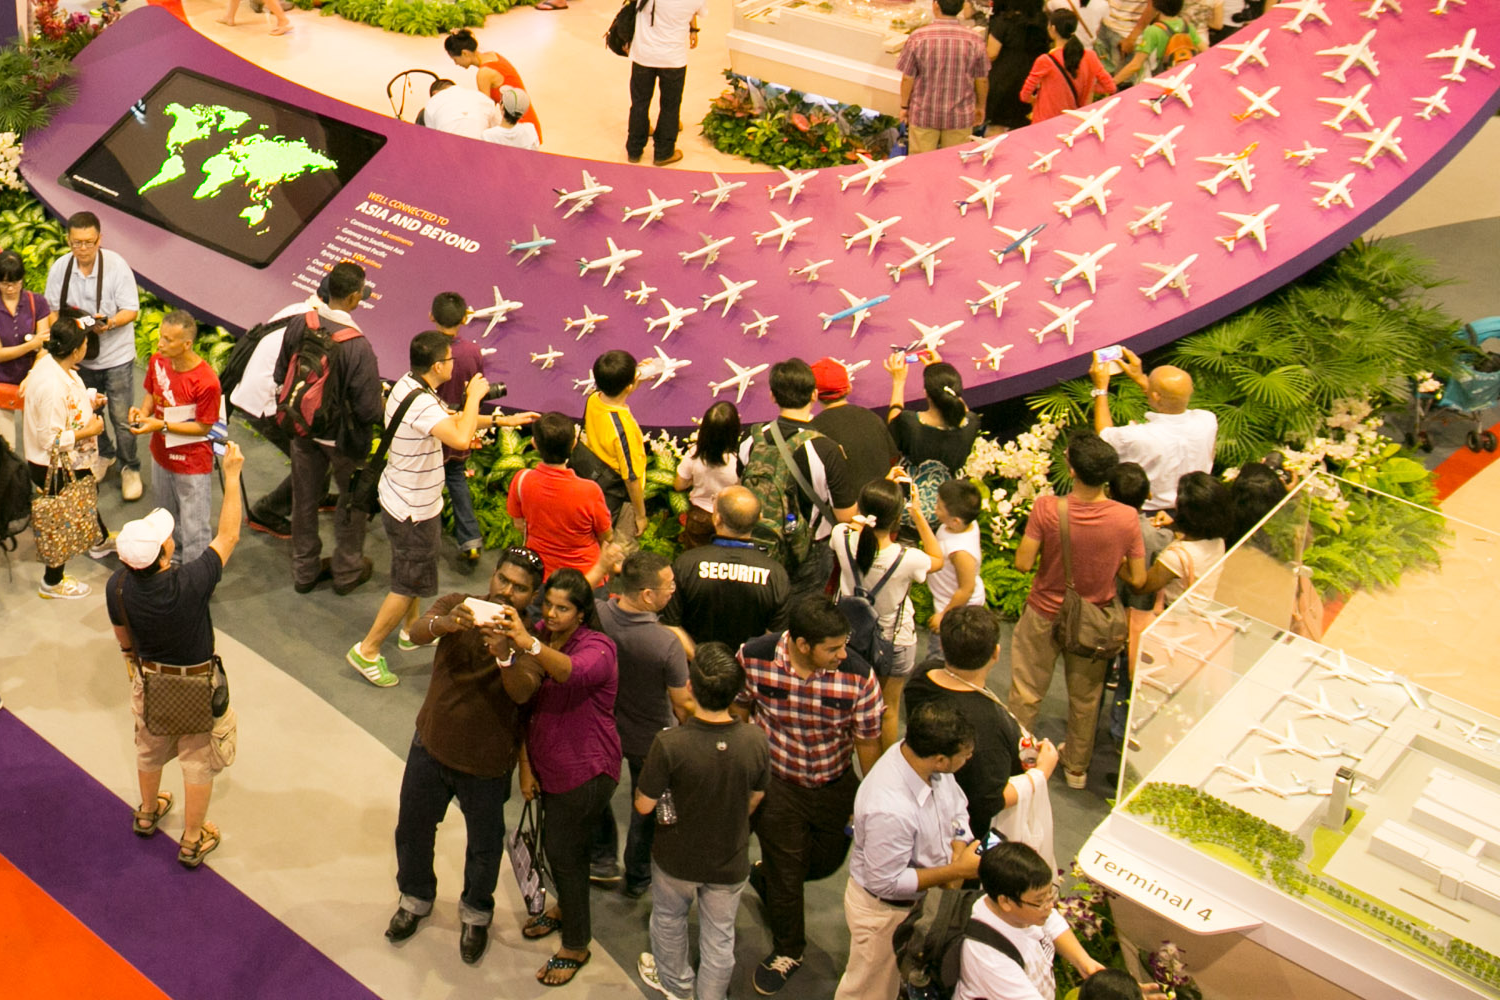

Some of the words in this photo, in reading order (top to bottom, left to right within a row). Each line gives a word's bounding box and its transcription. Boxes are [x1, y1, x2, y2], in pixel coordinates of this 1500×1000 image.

[355, 201, 390, 221] ASIA
[387, 212, 422, 231] AND
[419, 223, 482, 254] BEYOND
[367, 191, 390, 206] WELL
[388, 199, 439, 222] CONNECTED
[437, 215, 450, 227] TO
[698, 560, 771, 586] SECURITY
[1093, 849, 1193, 912] Terminal
[1196, 907, 1213, 922] 4
